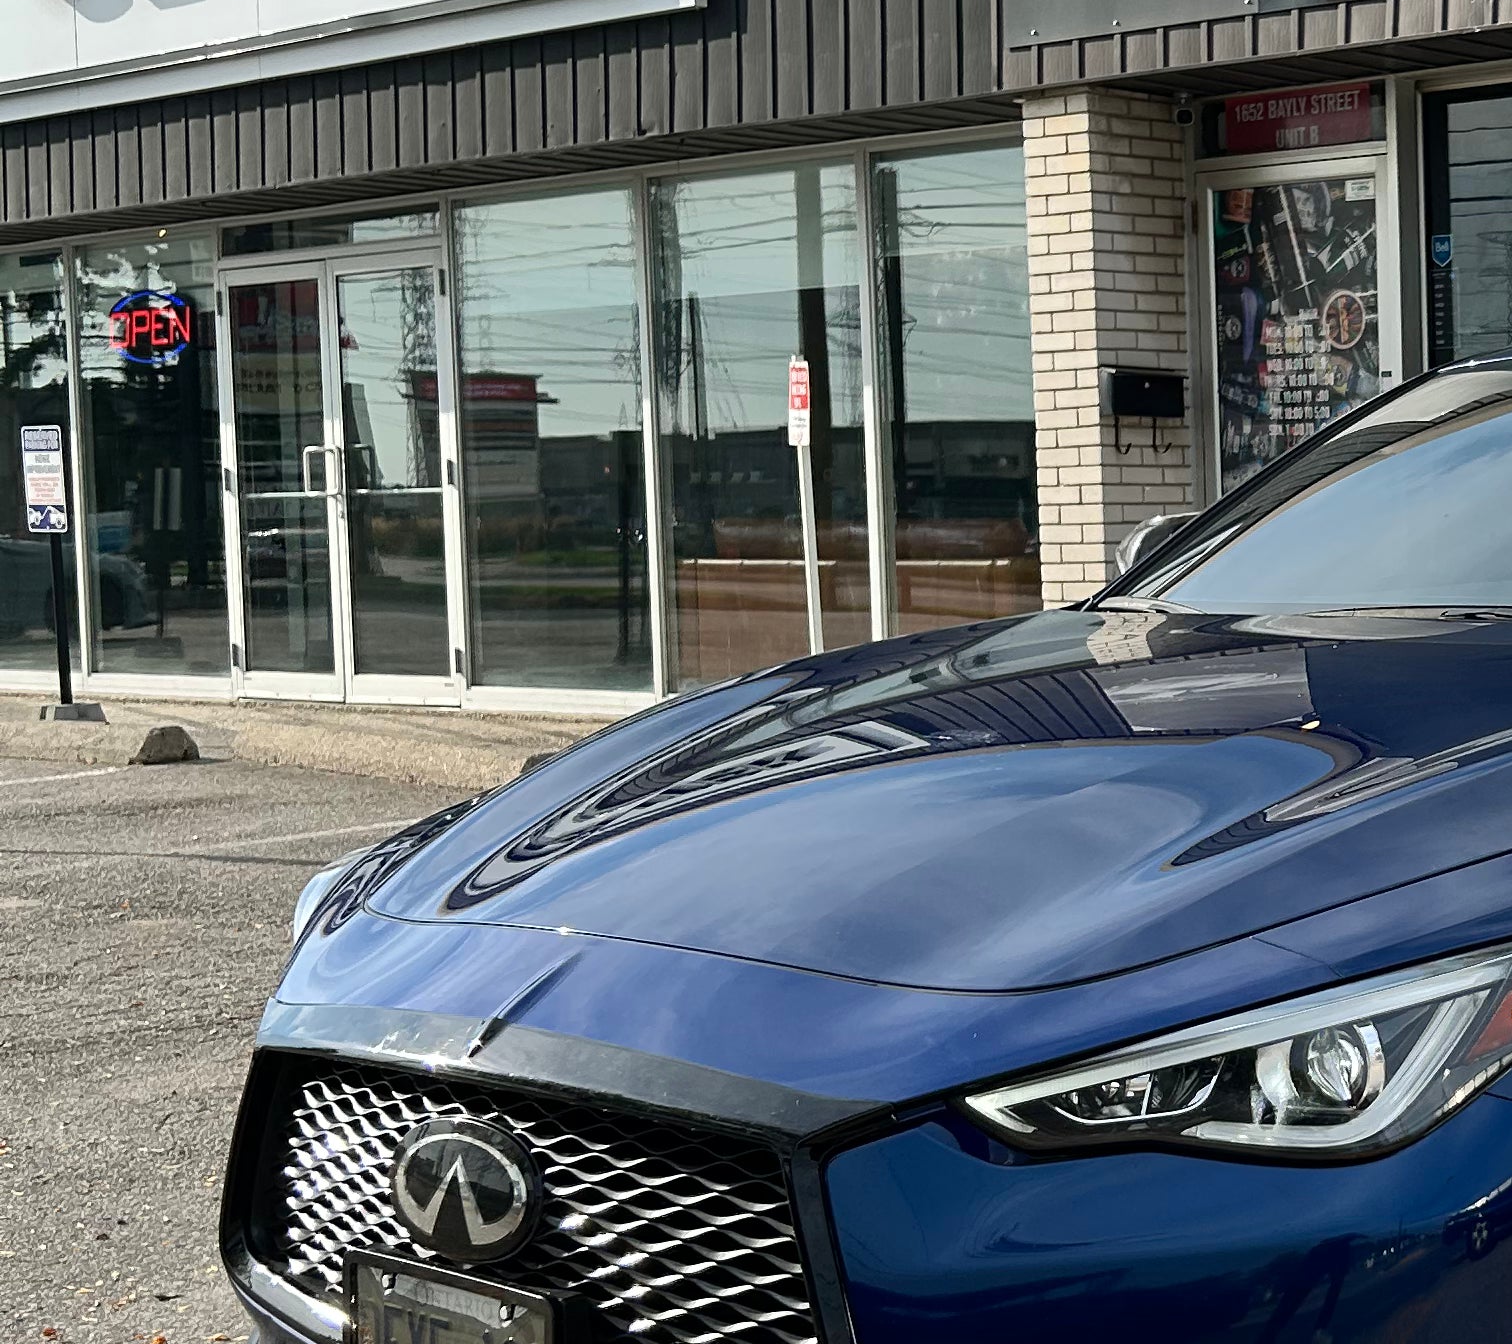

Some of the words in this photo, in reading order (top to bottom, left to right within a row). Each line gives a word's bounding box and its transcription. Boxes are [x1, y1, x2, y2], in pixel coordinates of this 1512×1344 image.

[1234, 101, 1265, 123] 1652
[1268, 96, 1307, 119] BAYLY
[1311, 90, 1361, 115] STREET
[1275, 126, 1306, 148] UNIT
[1309, 125, 1319, 145] B
[109, 306, 190, 349] OPEN
